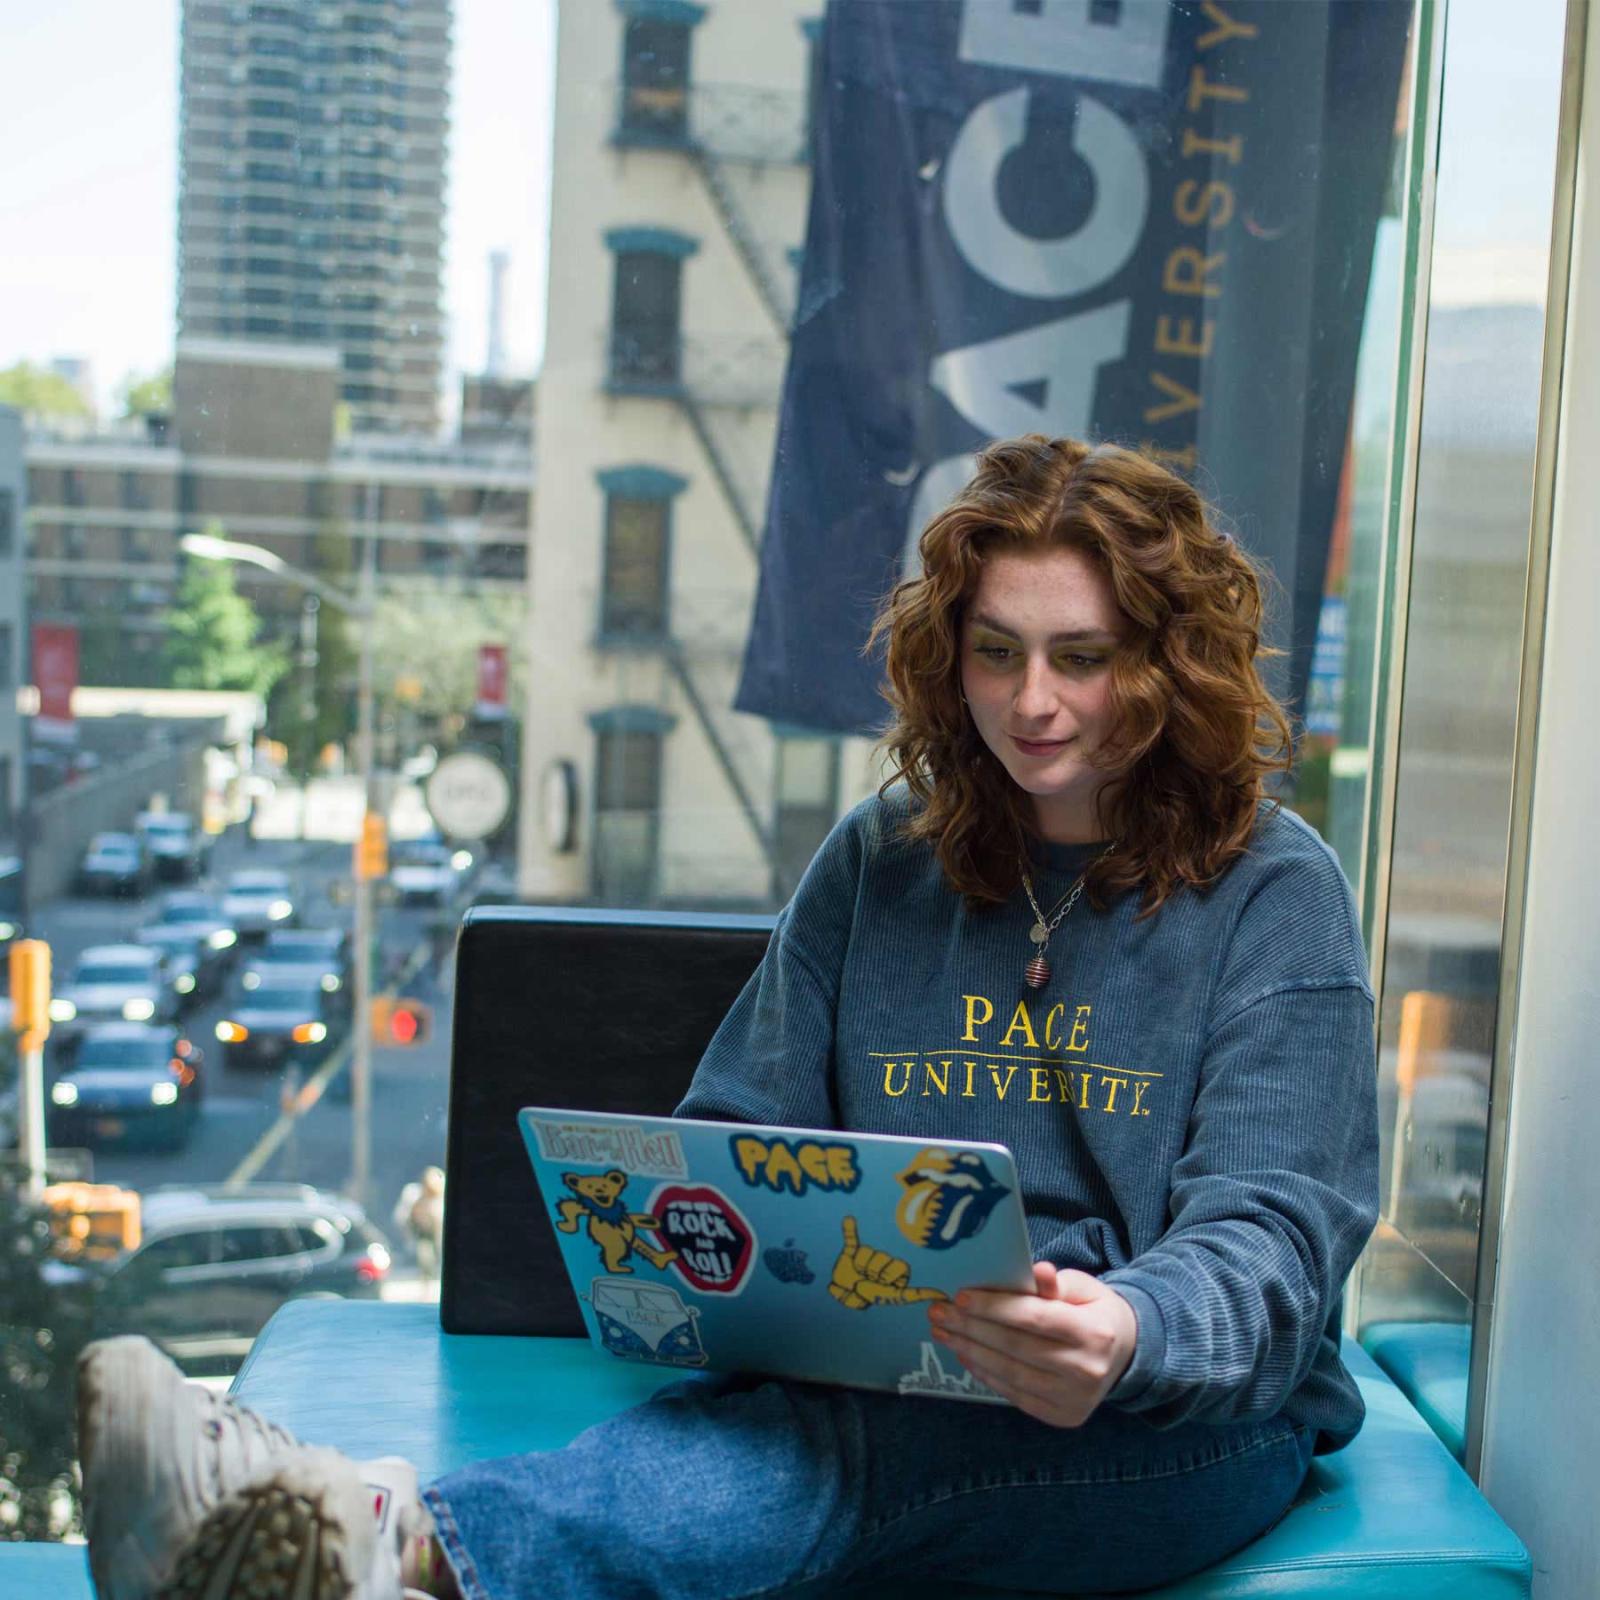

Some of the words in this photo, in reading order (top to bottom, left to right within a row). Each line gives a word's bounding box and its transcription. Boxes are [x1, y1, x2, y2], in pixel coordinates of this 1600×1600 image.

[902, 0, 1171, 578] ACE
[960, 995, 1091, 1051] PACE
[883, 1061, 1151, 1116] UNIVERITY
[729, 1133, 862, 1197] PACE
[668, 1211, 736, 1241] ROCK
